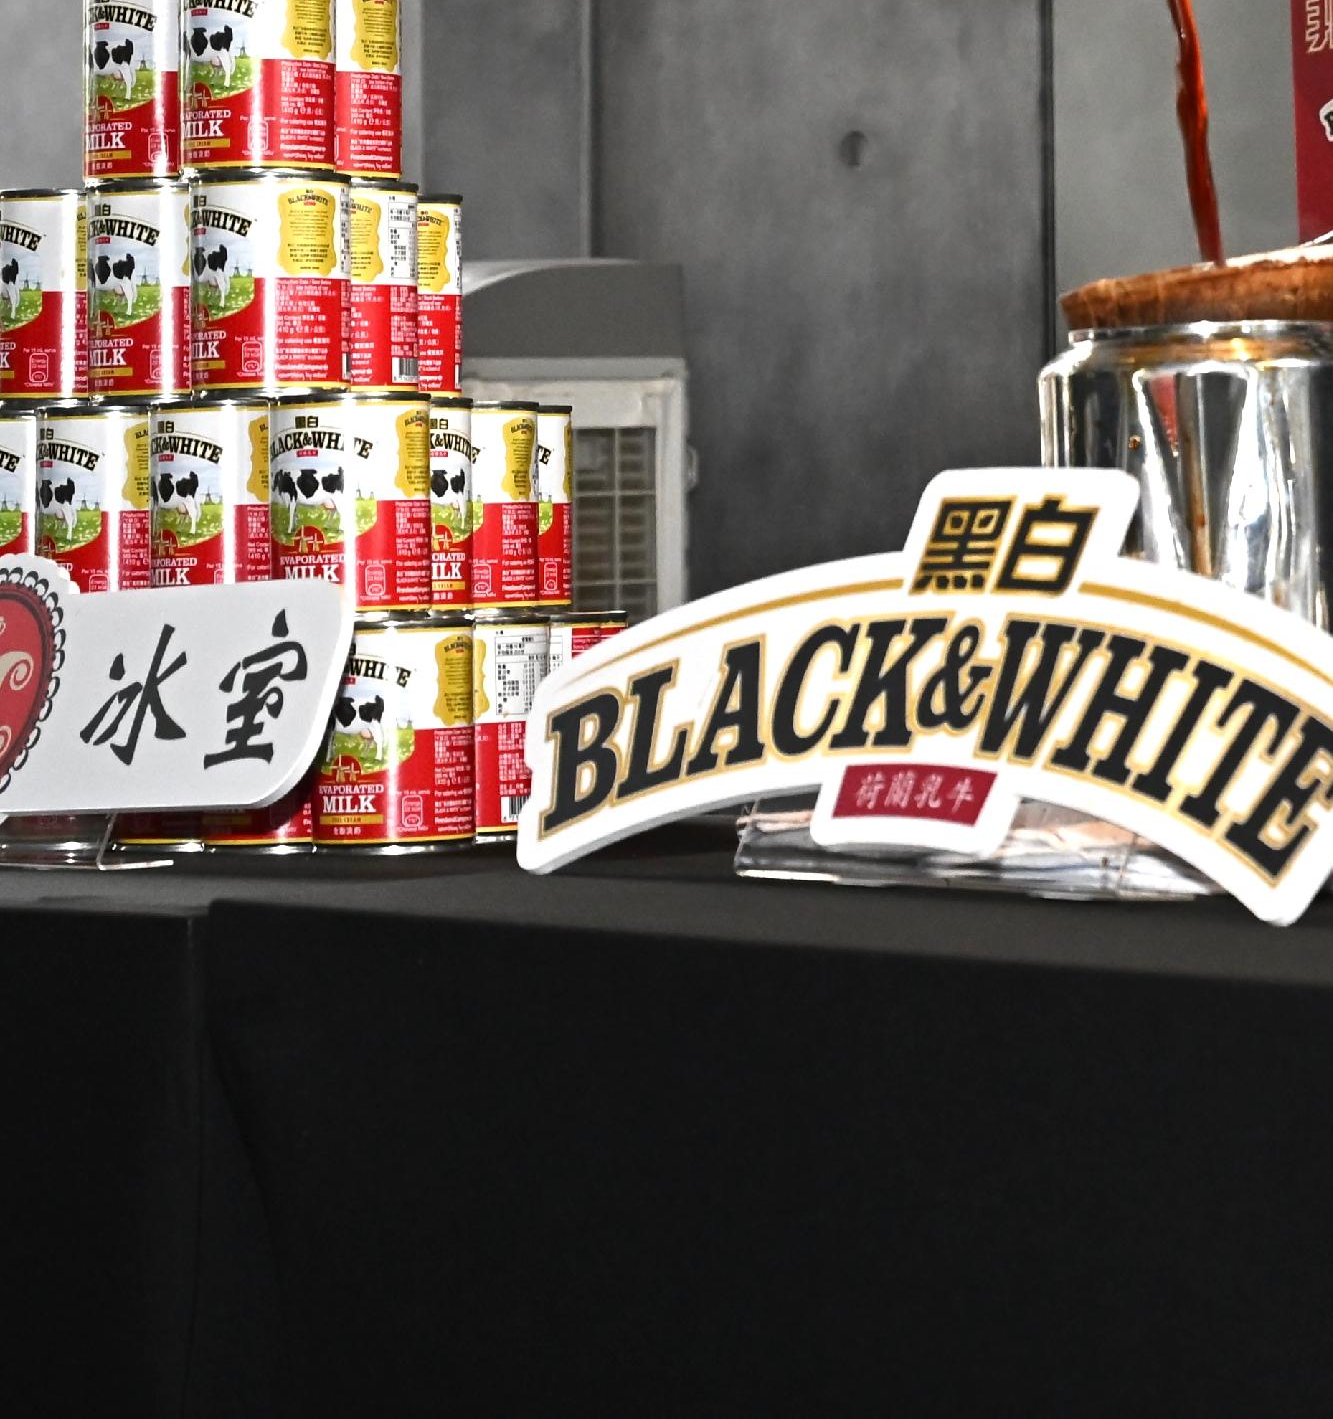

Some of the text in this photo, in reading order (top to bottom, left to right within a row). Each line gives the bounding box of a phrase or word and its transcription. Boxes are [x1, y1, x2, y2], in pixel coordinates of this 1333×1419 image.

[909, 493, 1100, 598] 黑白
[79, 609, 308, 769] 冰室
[319, 784, 384, 795] EVAPORATED
[323, 795, 376, 813] MILK
